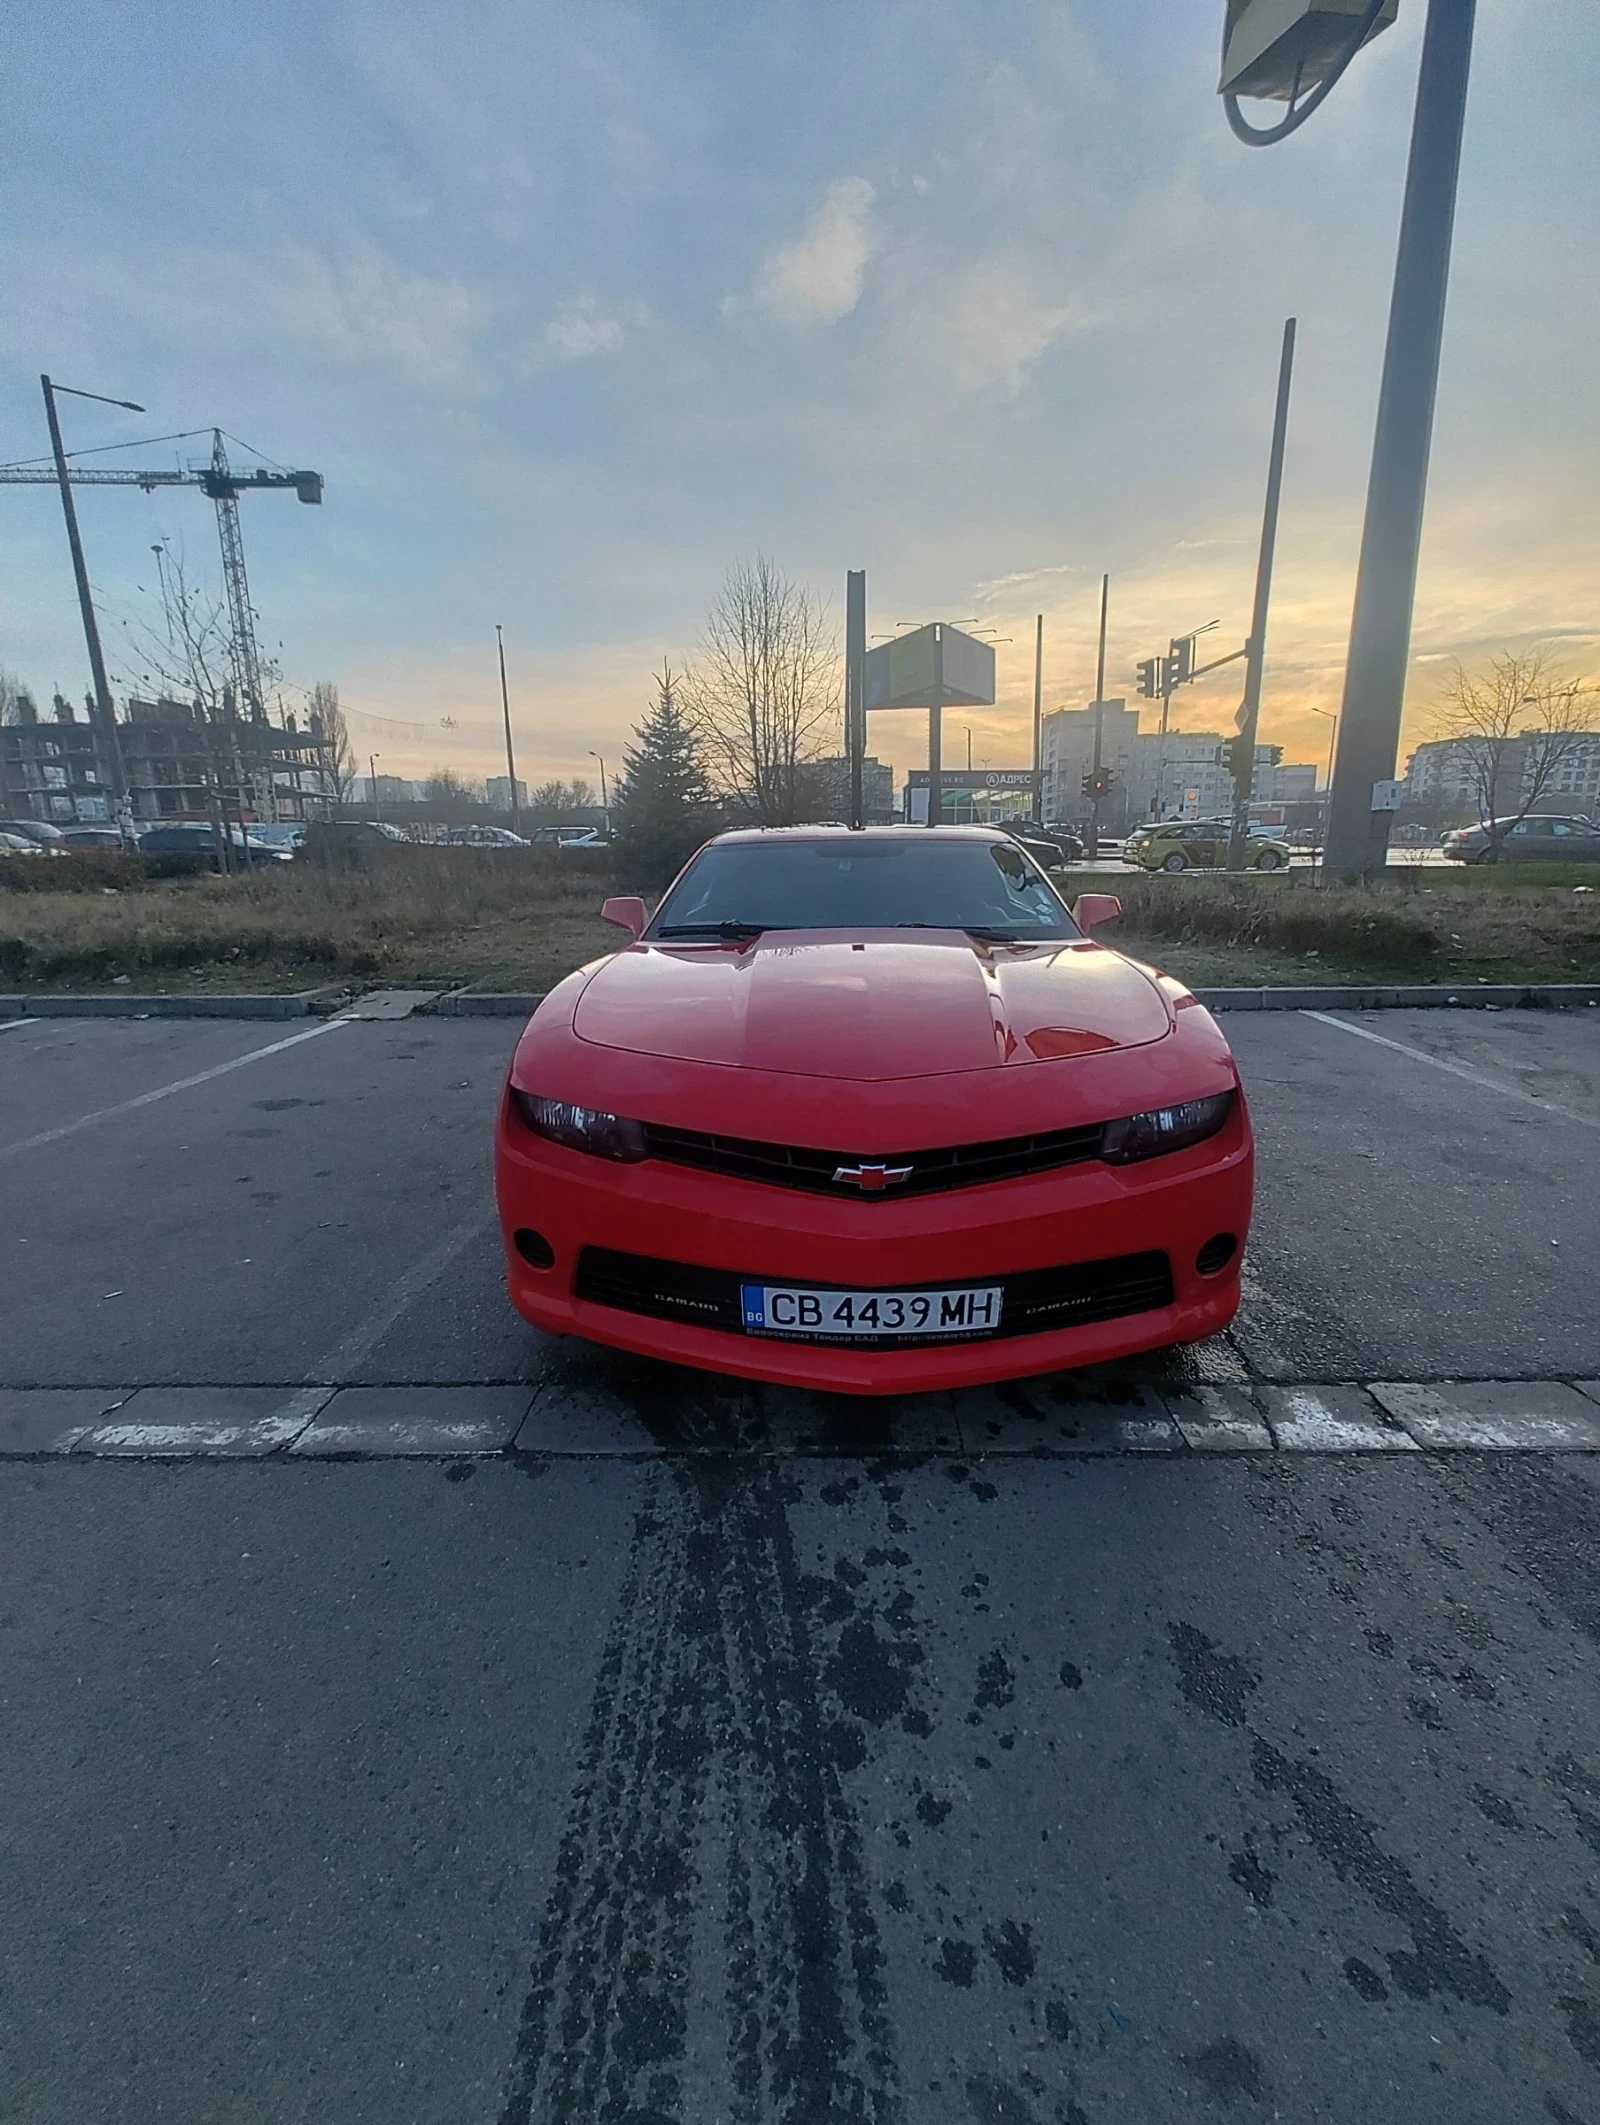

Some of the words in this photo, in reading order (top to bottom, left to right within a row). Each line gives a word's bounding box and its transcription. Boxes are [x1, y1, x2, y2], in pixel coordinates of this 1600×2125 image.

[999, 774, 1032, 784] АДРЕС
[771, 1293, 823, 1326] CB
[833, 1296, 930, 1329] 4439
[939, 1292, 993, 1327] MH
[747, 1311, 763, 1322] BG
